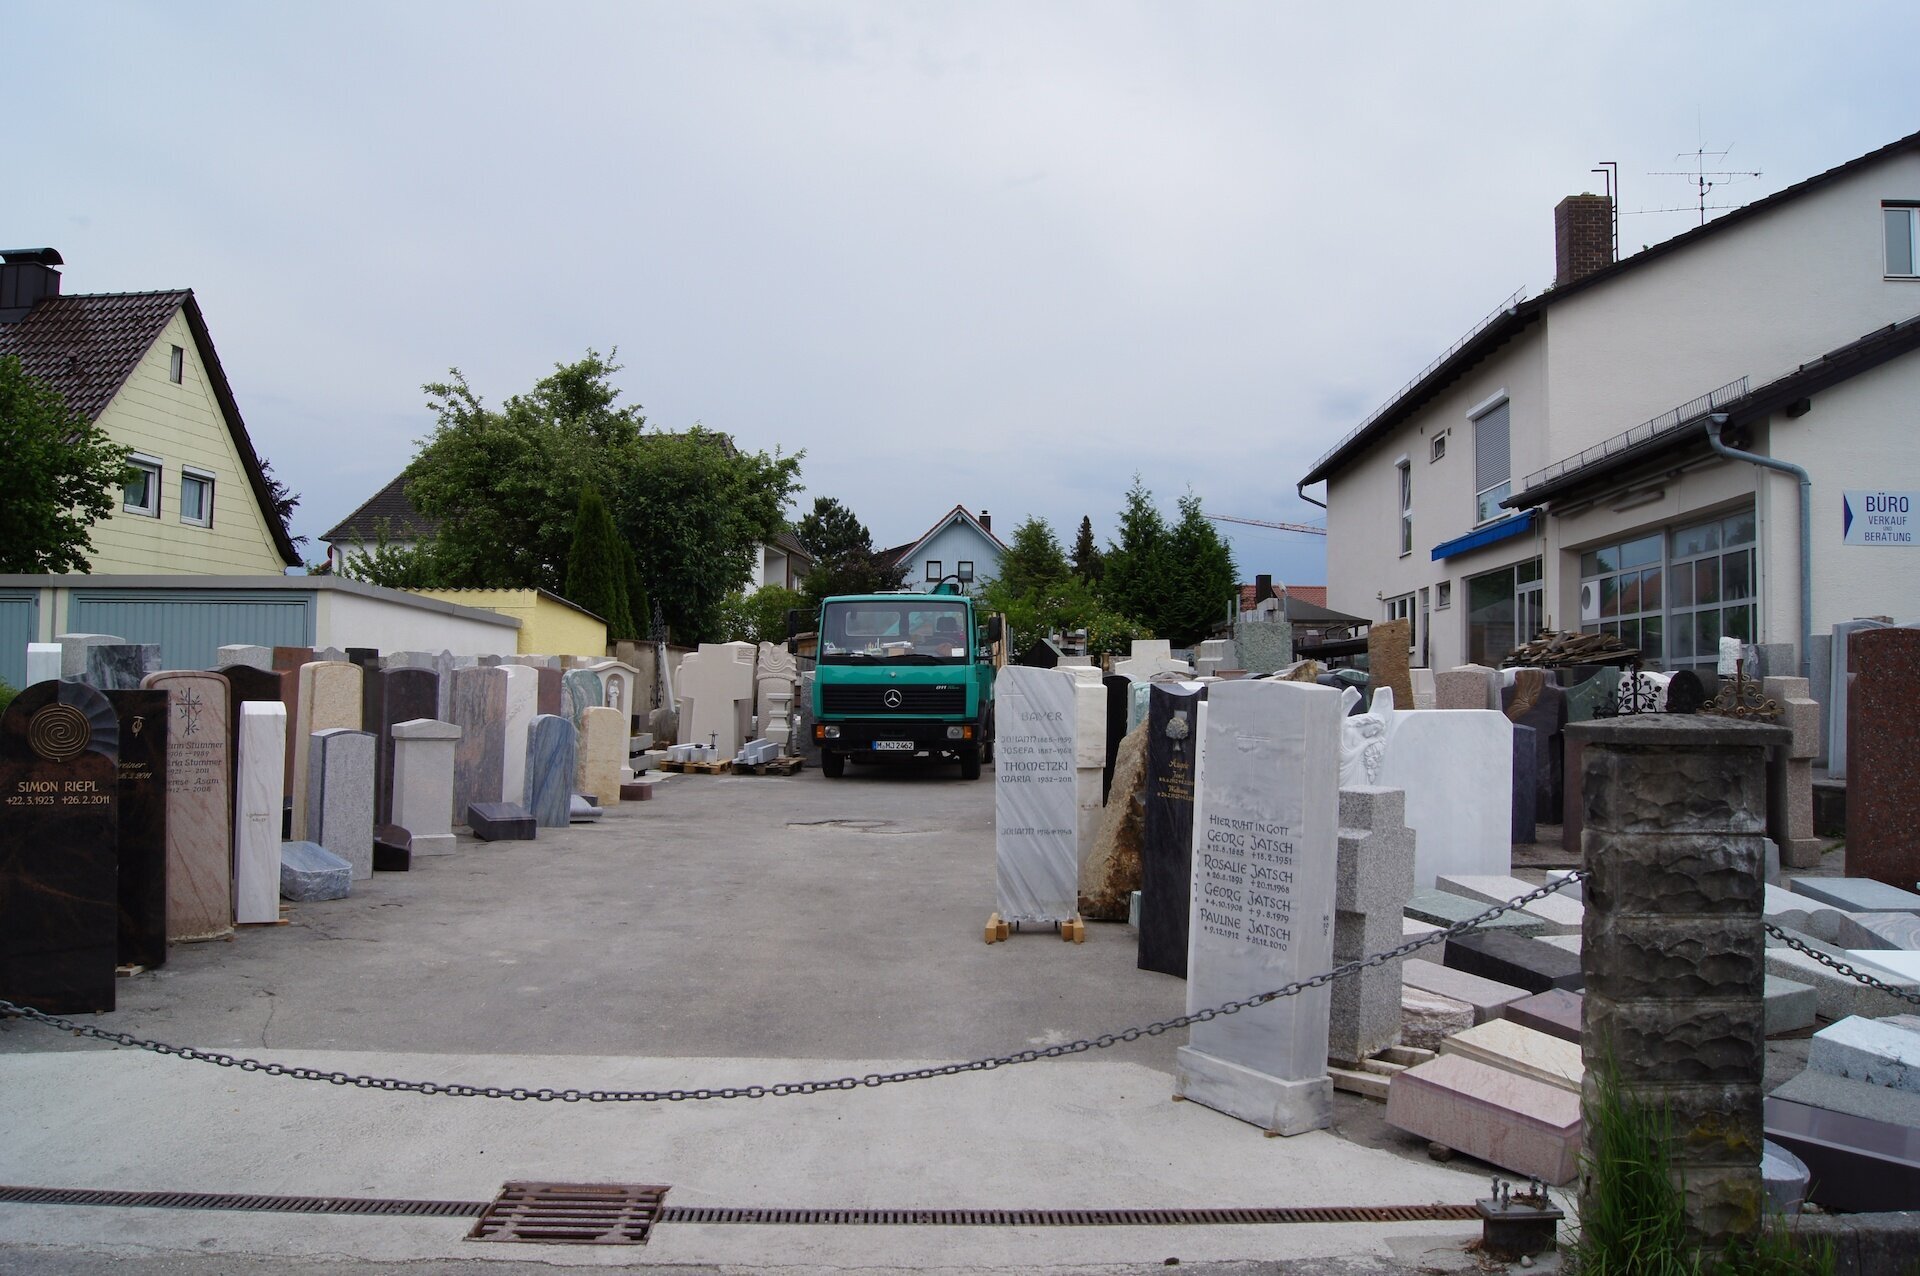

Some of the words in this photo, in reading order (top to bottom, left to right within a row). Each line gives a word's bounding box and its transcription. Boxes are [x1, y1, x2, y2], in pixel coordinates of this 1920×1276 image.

[1866, 492, 1909, 513] BÜRO
[1868, 515, 1907, 526] VERKAUF
[1864, 532, 1911, 542] BERATUNG
[1021, 711, 1063, 721] BAYER
[186, 741, 224, 750] Stummer
[1001, 746, 1034, 755] JOSEFA
[184, 758, 222, 767] Stummer
[1003, 761, 1068, 772] THOMETZKI
[1001, 775, 1032, 783] MARIA
[17, 781, 59, 793] SIMON
[64, 781, 99, 792] RIEPL
[1209, 814, 1231, 828] HIER
[1232, 819, 1254, 831] RUHT
[1255, 823, 1265, 832] IN
[1266, 824, 1289, 836] GOTT
[1207, 829, 1245, 847] GEORG
[1250, 834, 1293, 854] JATSCH
[1204, 854, 1247, 874] ROSALIE
[1250, 863, 1293, 883] JATSCH
[1205, 882, 1242, 902] GEORG
[1248, 889, 1291, 912] JATSCH
[1200, 907, 1241, 929] PAULINE
[1248, 918, 1291, 941] JATSCH
